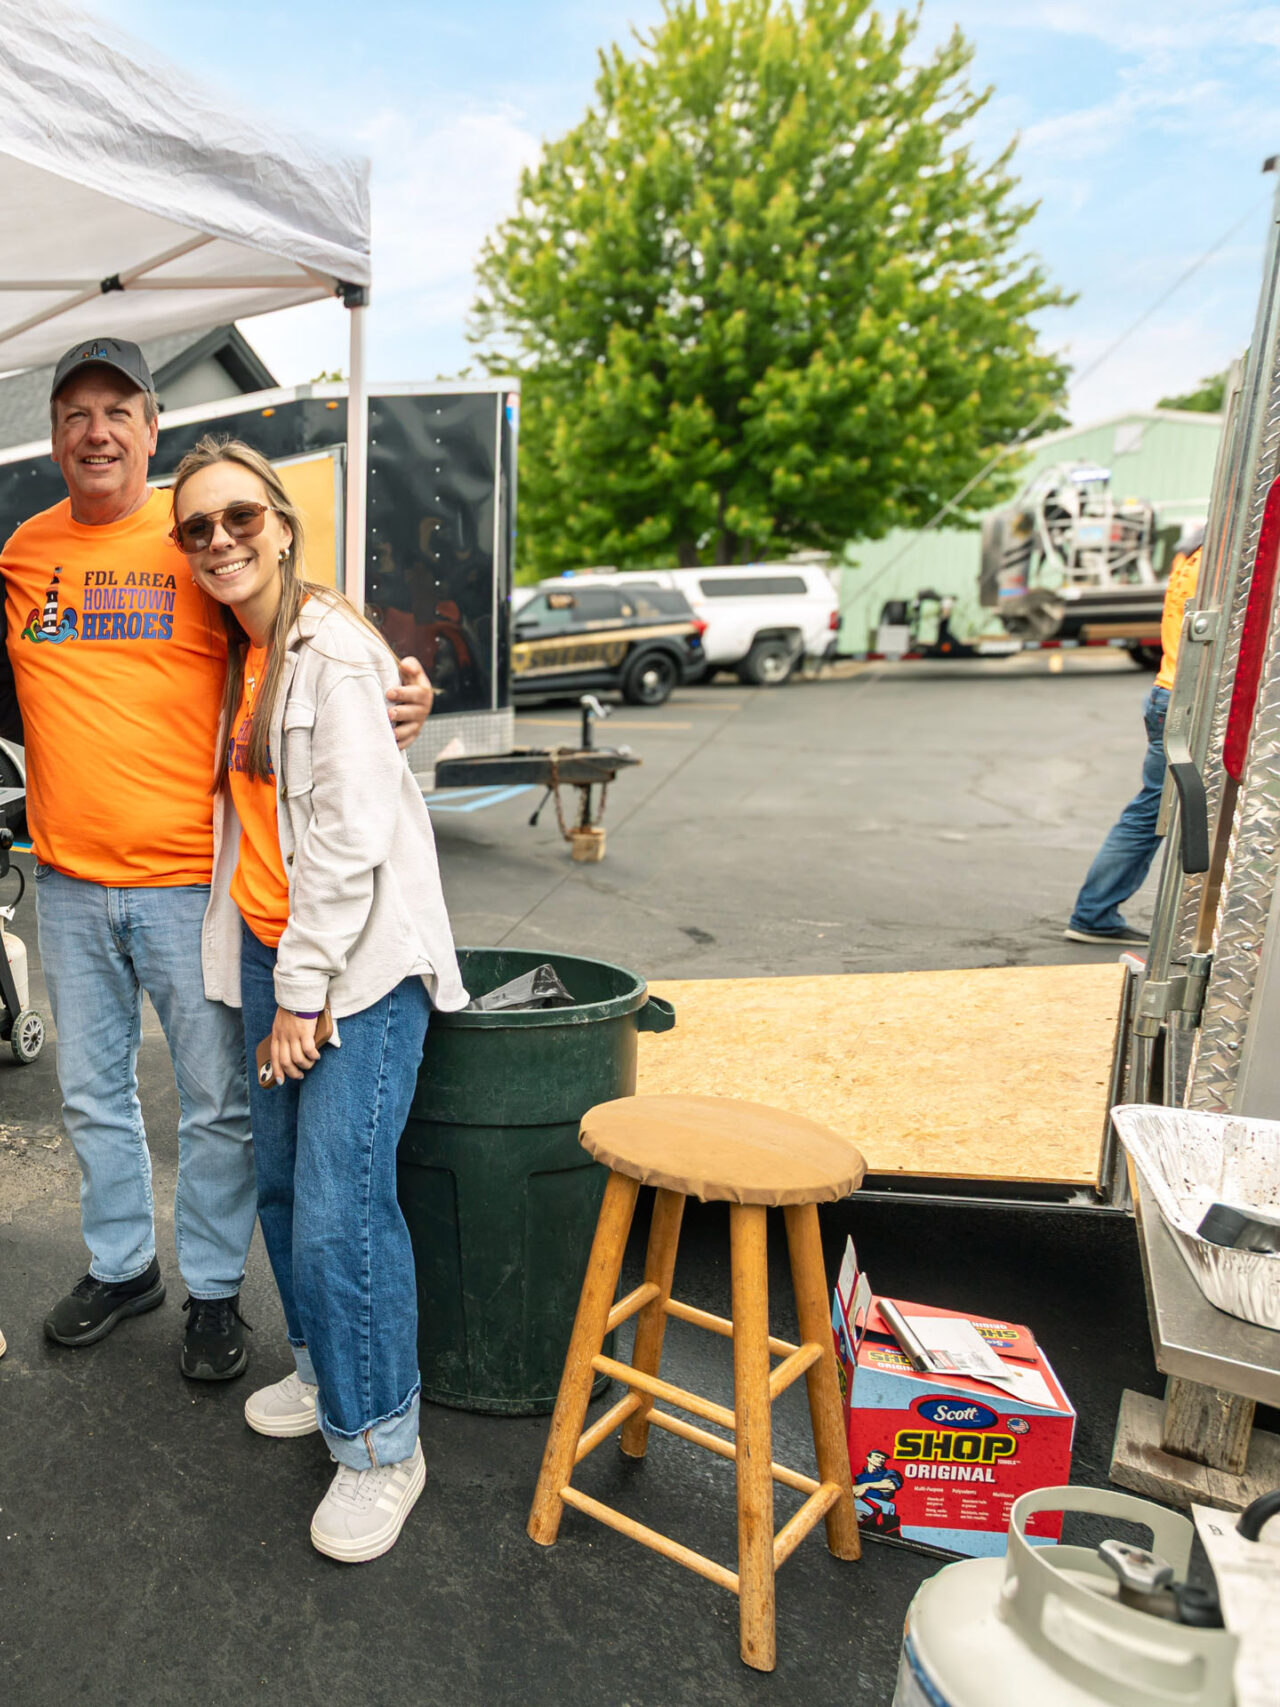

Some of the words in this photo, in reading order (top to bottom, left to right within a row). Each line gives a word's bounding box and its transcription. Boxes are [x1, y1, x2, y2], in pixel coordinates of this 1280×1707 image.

[84, 571, 118, 586] FDL
[124, 571, 176, 589] AREA
[83, 588, 176, 612] HOMETOWN
[81, 611, 174, 640] HEROES
[975, 1327, 1019, 1339] SHO
[868, 1350, 912, 1366] SHO
[933, 1405, 978, 1421] Scott
[893, 1429, 1017, 1464] SHOP
[904, 1463, 996, 1483] ORIGINAL
